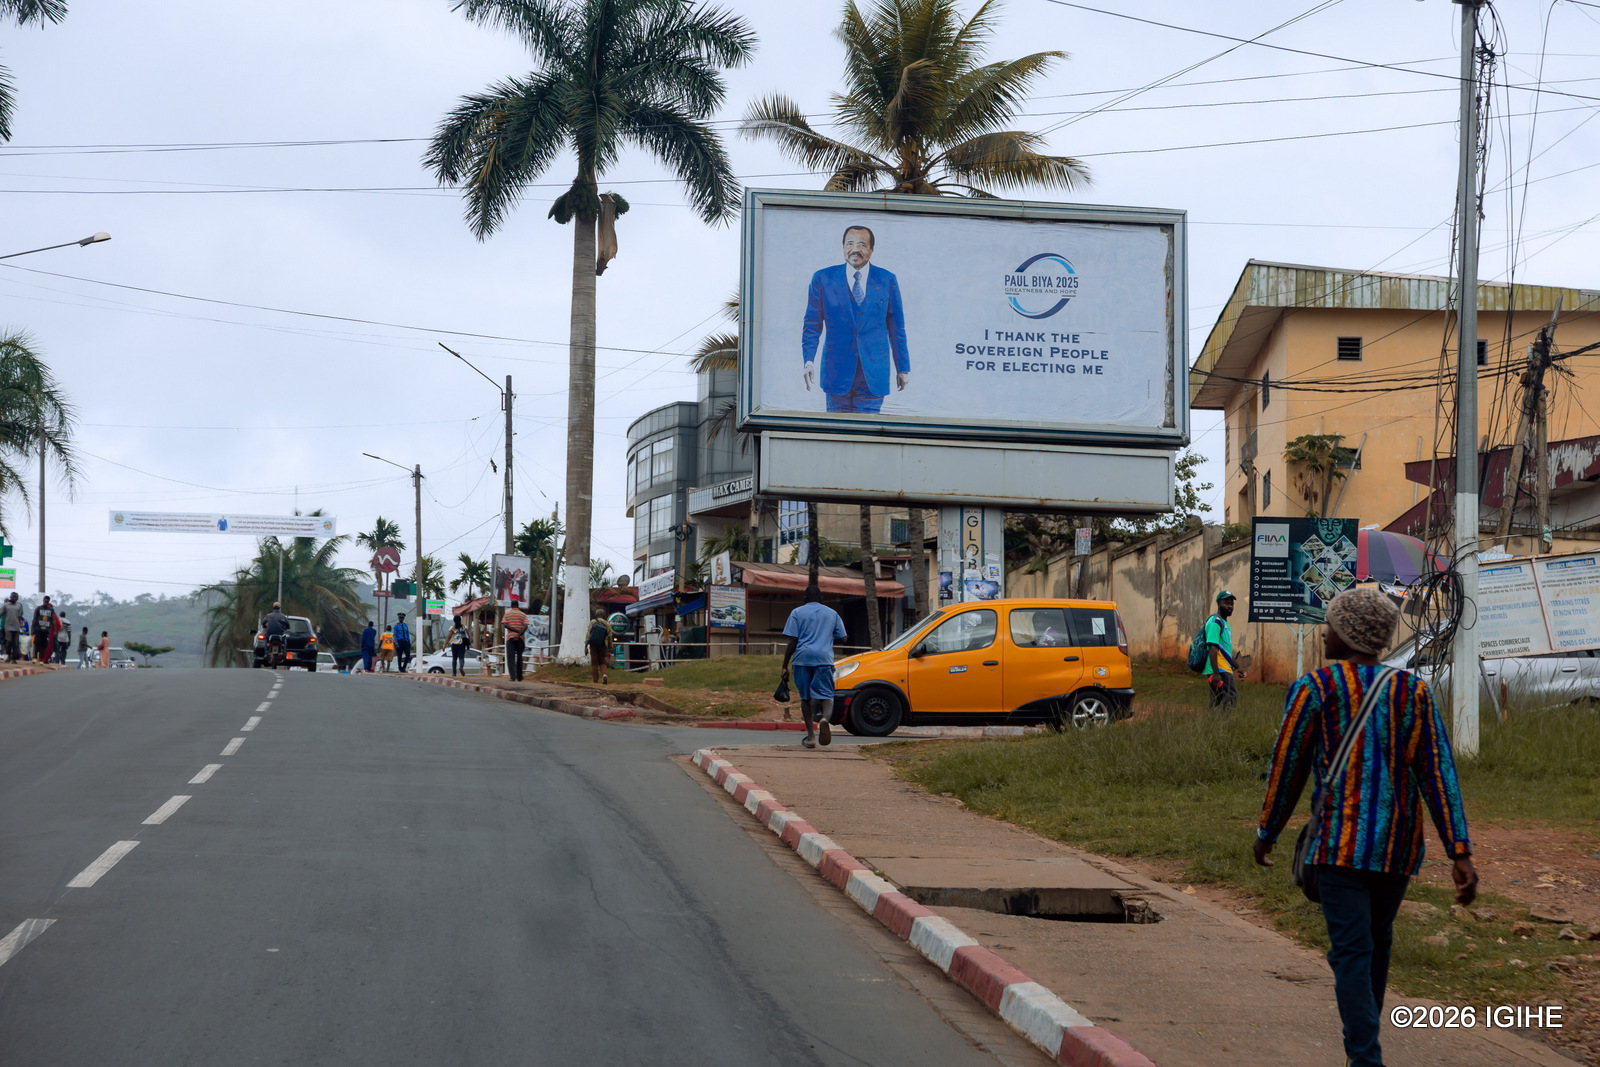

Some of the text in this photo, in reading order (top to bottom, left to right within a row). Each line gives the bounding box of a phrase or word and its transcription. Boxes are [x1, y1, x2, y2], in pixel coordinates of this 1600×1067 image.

[1004, 274, 1078, 289] PAUL BIYA 2025
[984, 329, 1080, 344] I THANK THE
[966, 360, 1104, 376] FOR ELECTING ME
[1481, 640, 1498, 648] ESPACES
